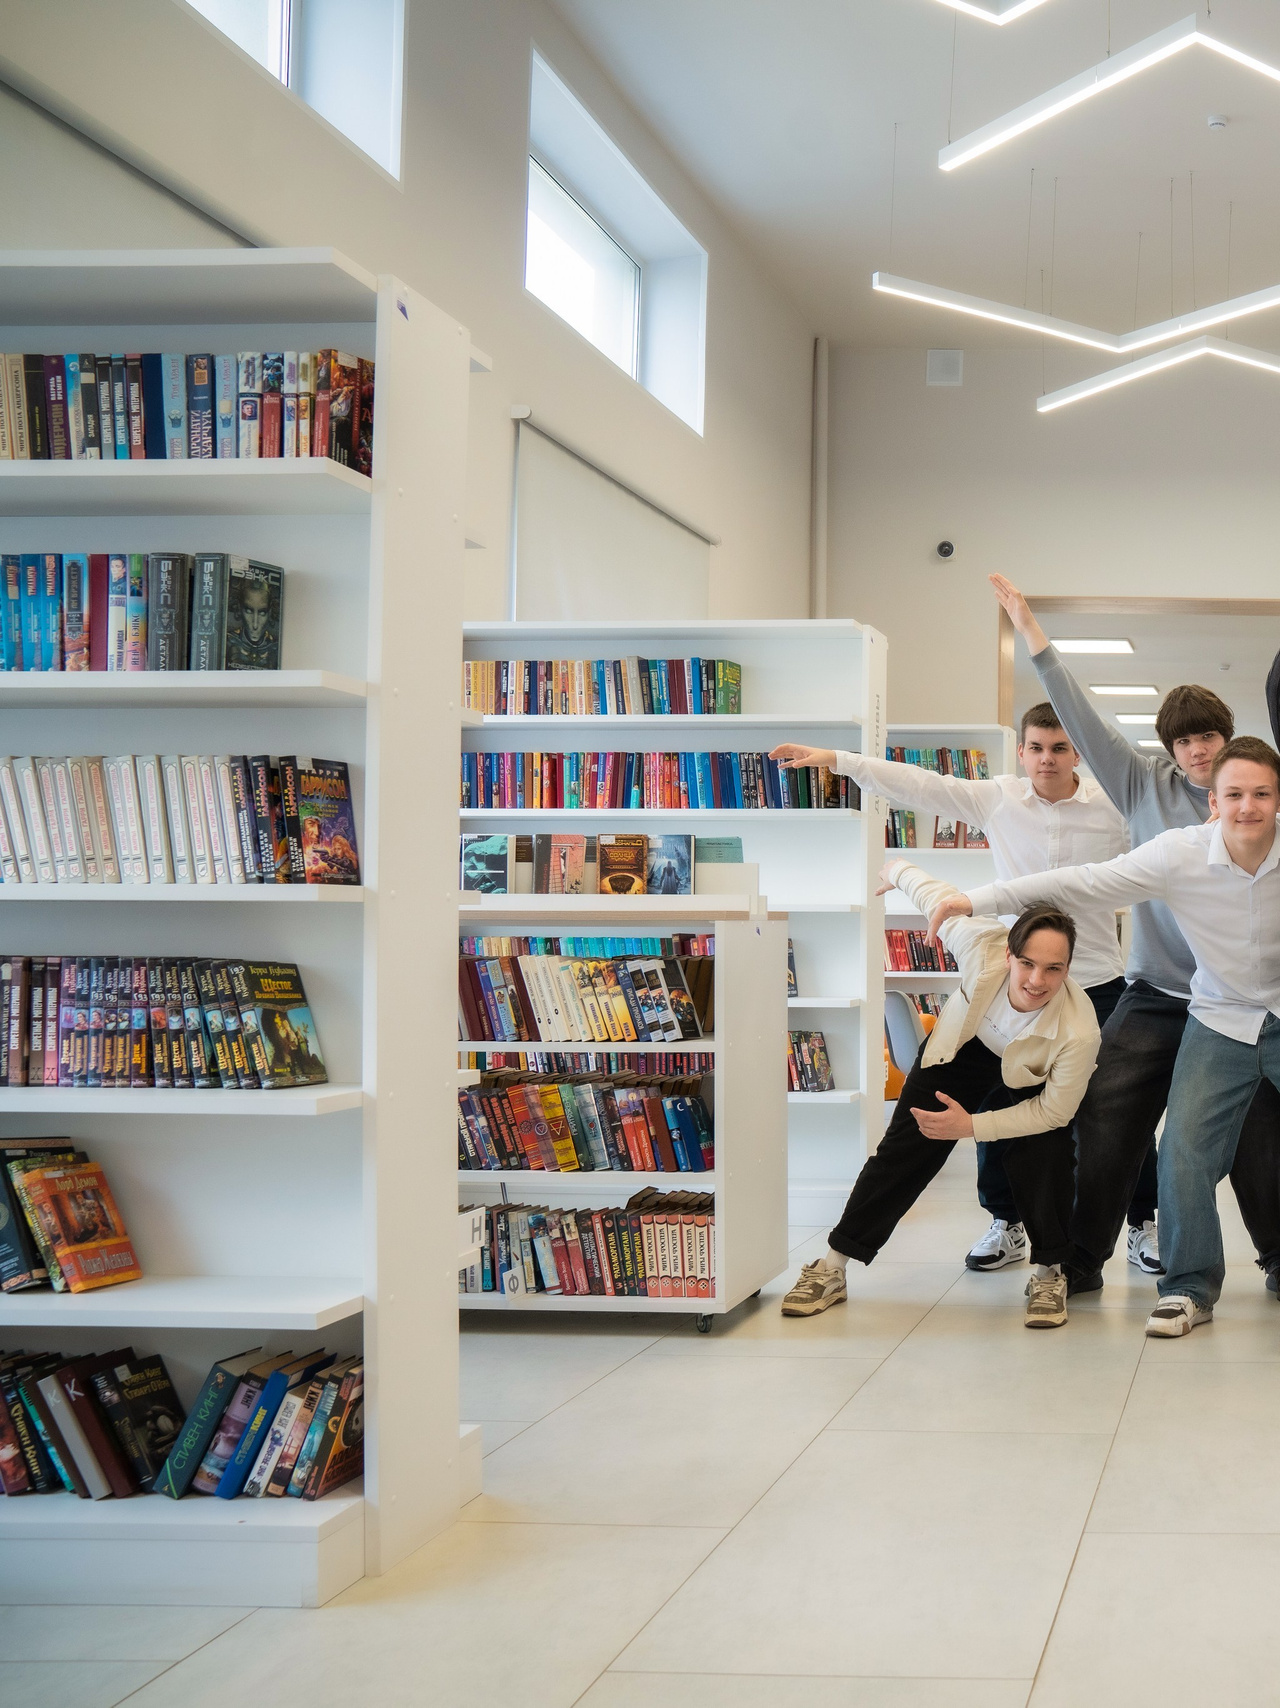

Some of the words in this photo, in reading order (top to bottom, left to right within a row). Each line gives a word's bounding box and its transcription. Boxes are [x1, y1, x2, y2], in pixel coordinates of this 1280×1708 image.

[100, 381, 110, 411] МАТЕРИАЛЫ
[114, 382, 123, 412] МАТЕРИАЛЫ
[130, 382, 140, 413] МАТЕРИАЛЫ
[102, 414, 112, 443] СЕКРЕТНЫЕ
[116, 414, 125, 444] СЕКРЕТНЫЕ
[132, 415, 141, 445] СЕКРЕТНЫЕ
[74, 769, 84, 804] ГАРРИСОНА
[92, 767, 103, 802] ГАРРИСОНА
[187, 767, 196, 802] ГАРРИСОНА
[257, 767, 269, 816] ГАРРИСОН
[286, 766, 298, 816] ГАРРИСОН
[301, 775, 348, 799] ГАРРИСОН
[80, 807, 88, 827] ГАРРИ
[98, 806, 106, 826] ГАРРИ
[101, 830, 109, 849] МИРЫ
[10, 986, 20, 1016] МАТЕРИАЛЫ
[32, 987, 43, 1018] МАТЕРИАЛЫ
[10, 1019, 19, 1050] СЕКРЕТНЫЕ
[31, 1021, 42, 1051] СЕКРЕТНЫЕ
[55, 1176, 74, 1191] Лорд
[74, 1175, 98, 1190] Демон
[471, 1215, 482, 1245] Н
[509, 1273, 519, 1294] Ф
[240, 1389, 257, 1409] КИНГ
[303, 1390, 321, 1413] КИНГ
[173, 1422, 203, 1469] СТИВЕН
[199, 1387, 219, 1421] КИНГ
